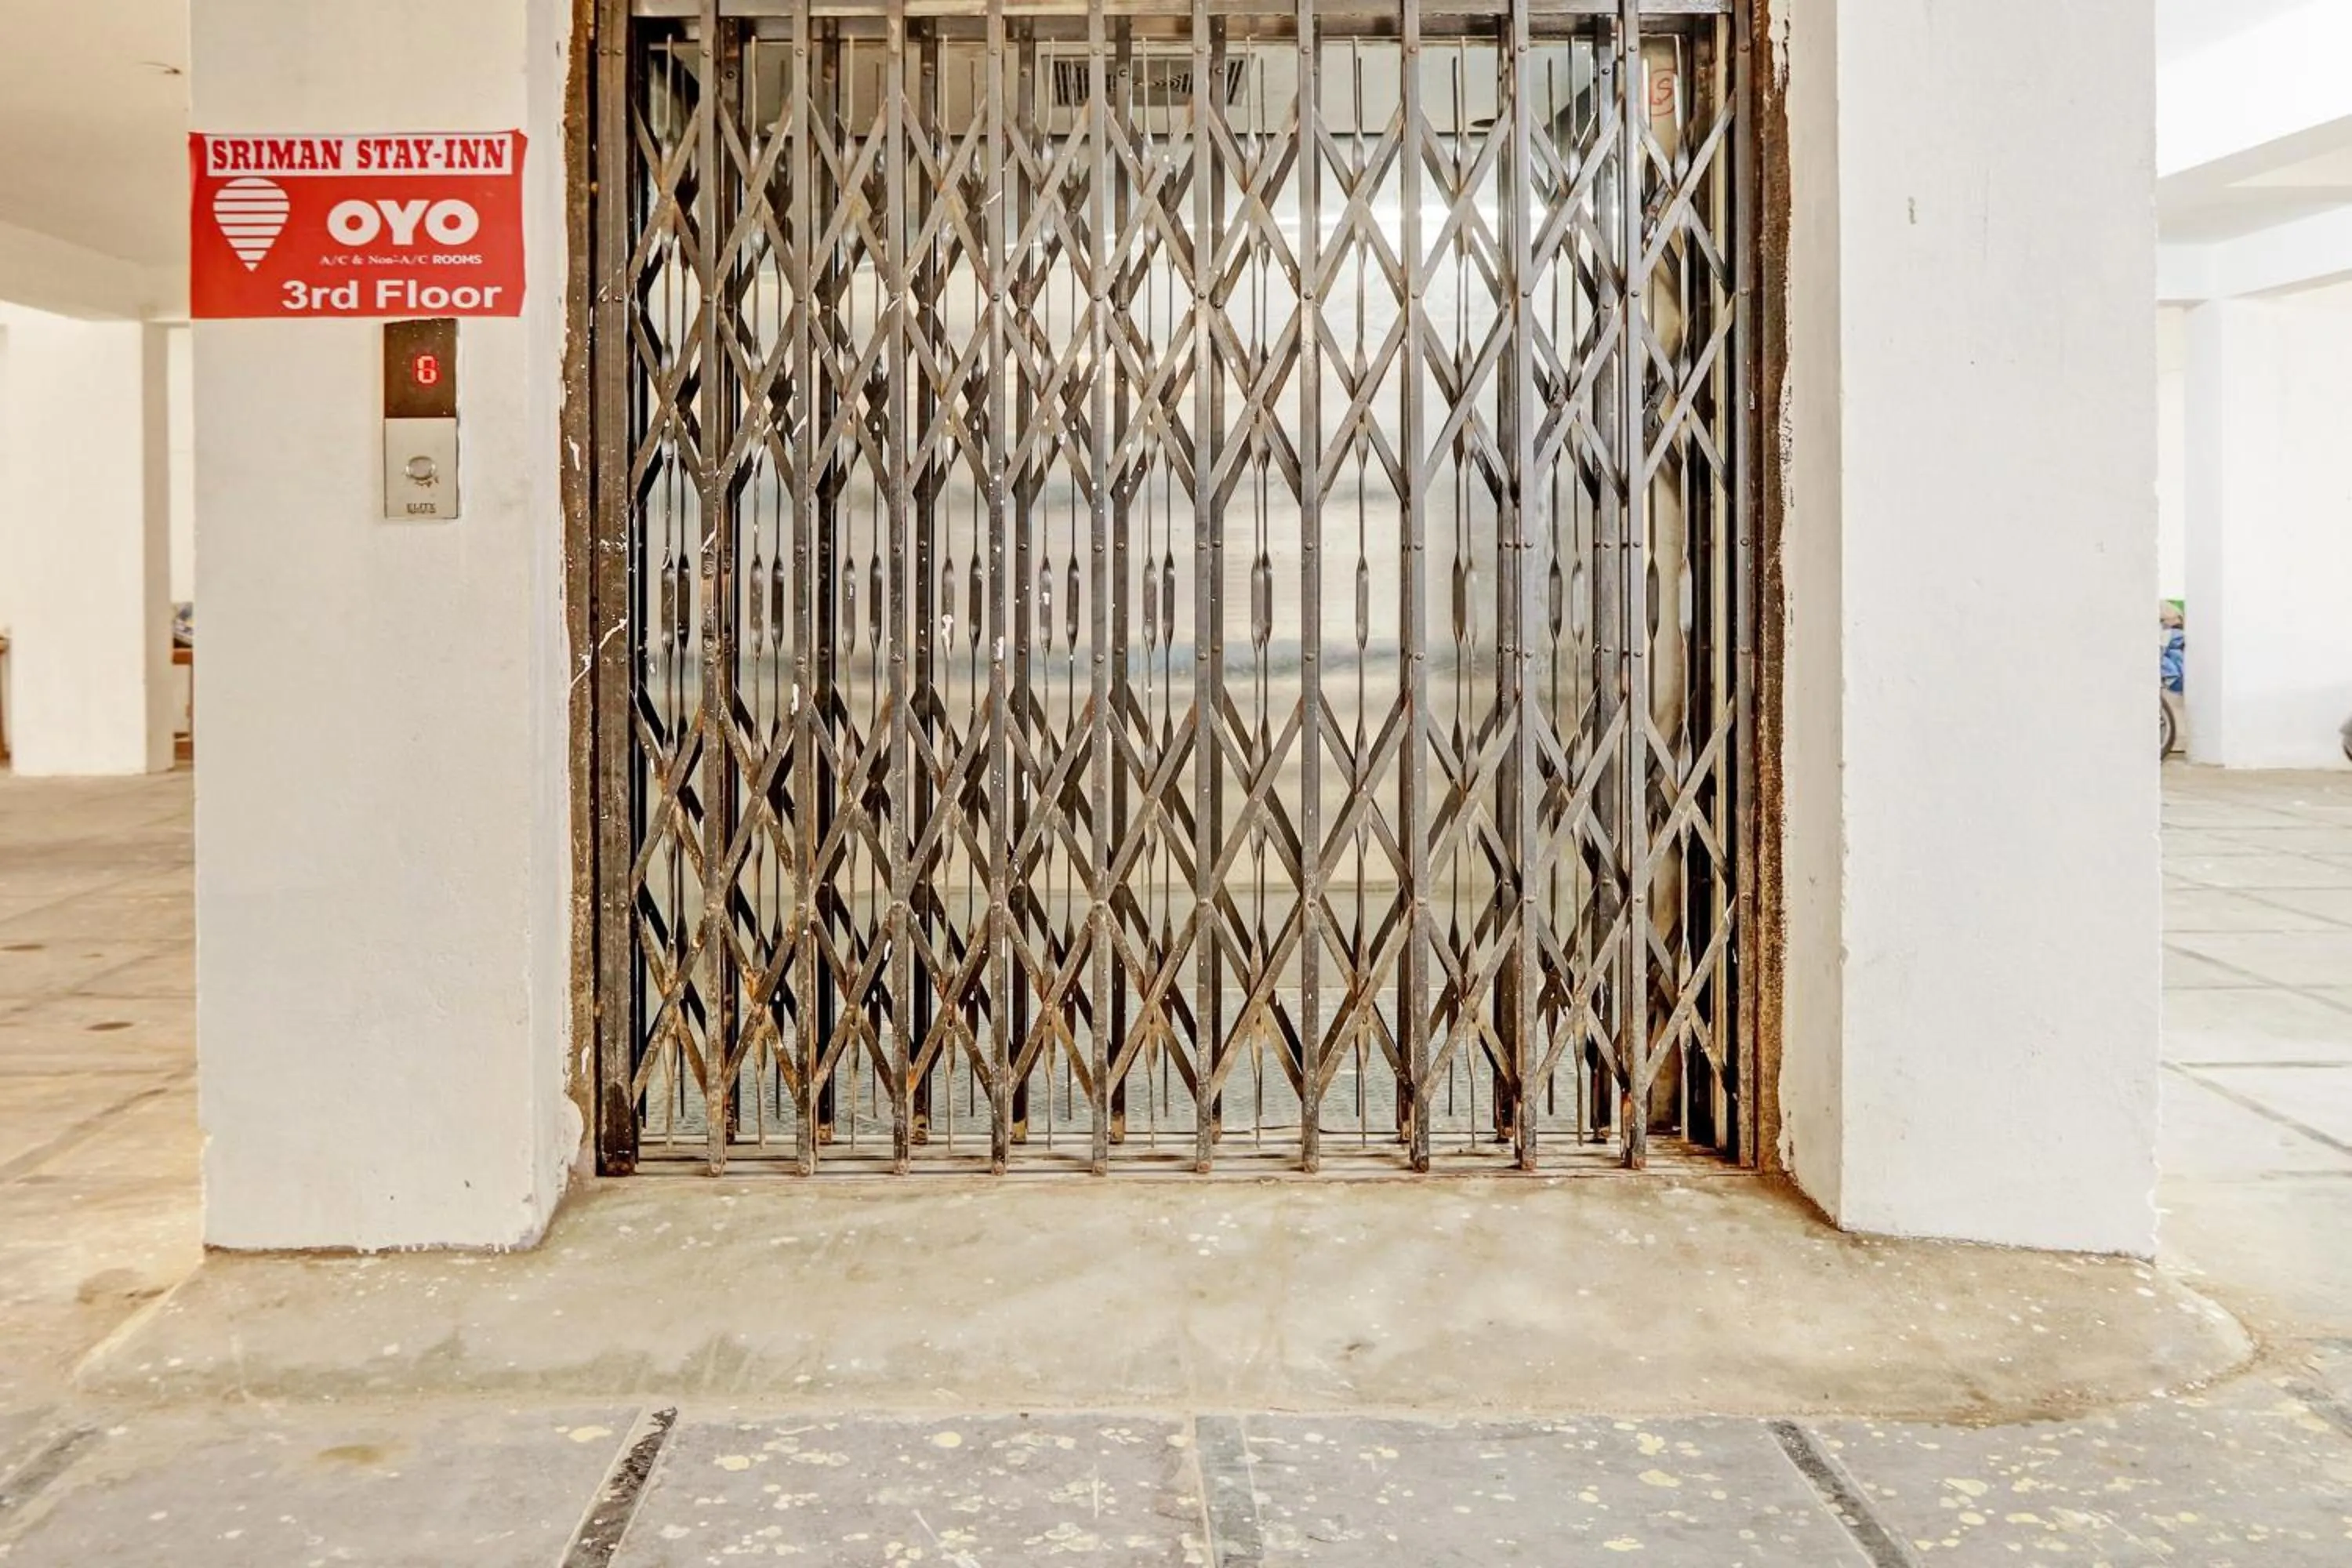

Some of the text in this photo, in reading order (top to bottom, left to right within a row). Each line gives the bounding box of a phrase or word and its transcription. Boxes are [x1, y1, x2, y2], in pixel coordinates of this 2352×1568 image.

[212, 139, 506, 169] SRIMAN STAY-INN
[327, 198, 479, 245] OYO
[320, 255, 348, 265] A/C
[352, 255, 363, 265] &
[433, 255, 483, 264] ROOMS
[282, 279, 502, 310] 3rd Floor
